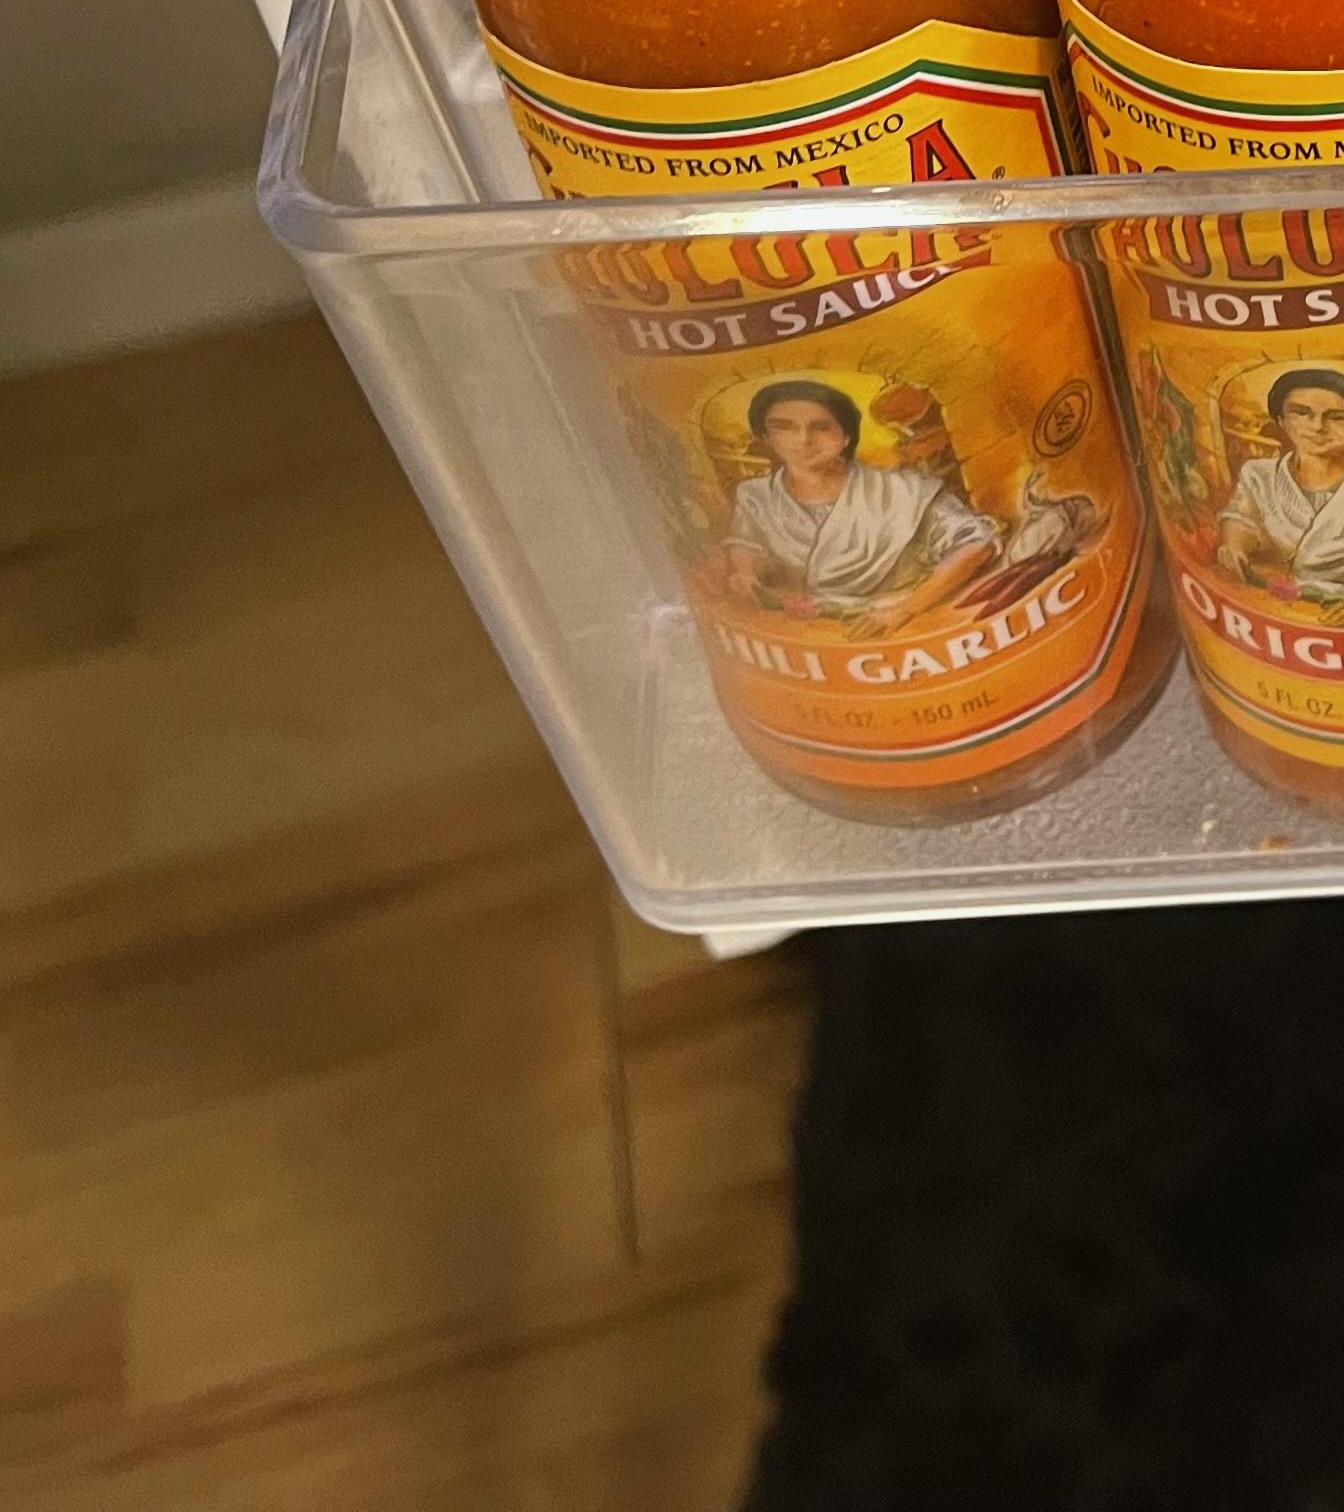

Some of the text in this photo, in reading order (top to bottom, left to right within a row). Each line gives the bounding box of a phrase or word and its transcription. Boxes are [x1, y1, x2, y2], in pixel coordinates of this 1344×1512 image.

[1092, 74, 1217, 150] IMPORTED
[1229, 137, 1323, 161] FROM
[523, 111, 904, 178] IMPORTED FROM MEXICO
[1166, 287, 1284, 327] HOT
[632, 314, 747, 351] HOT
[847, 570, 1087, 684] GARLIC
[911, 704, 953, 726] 150
[961, 691, 998, 716] mL
[1275, 688, 1298, 711] FL
